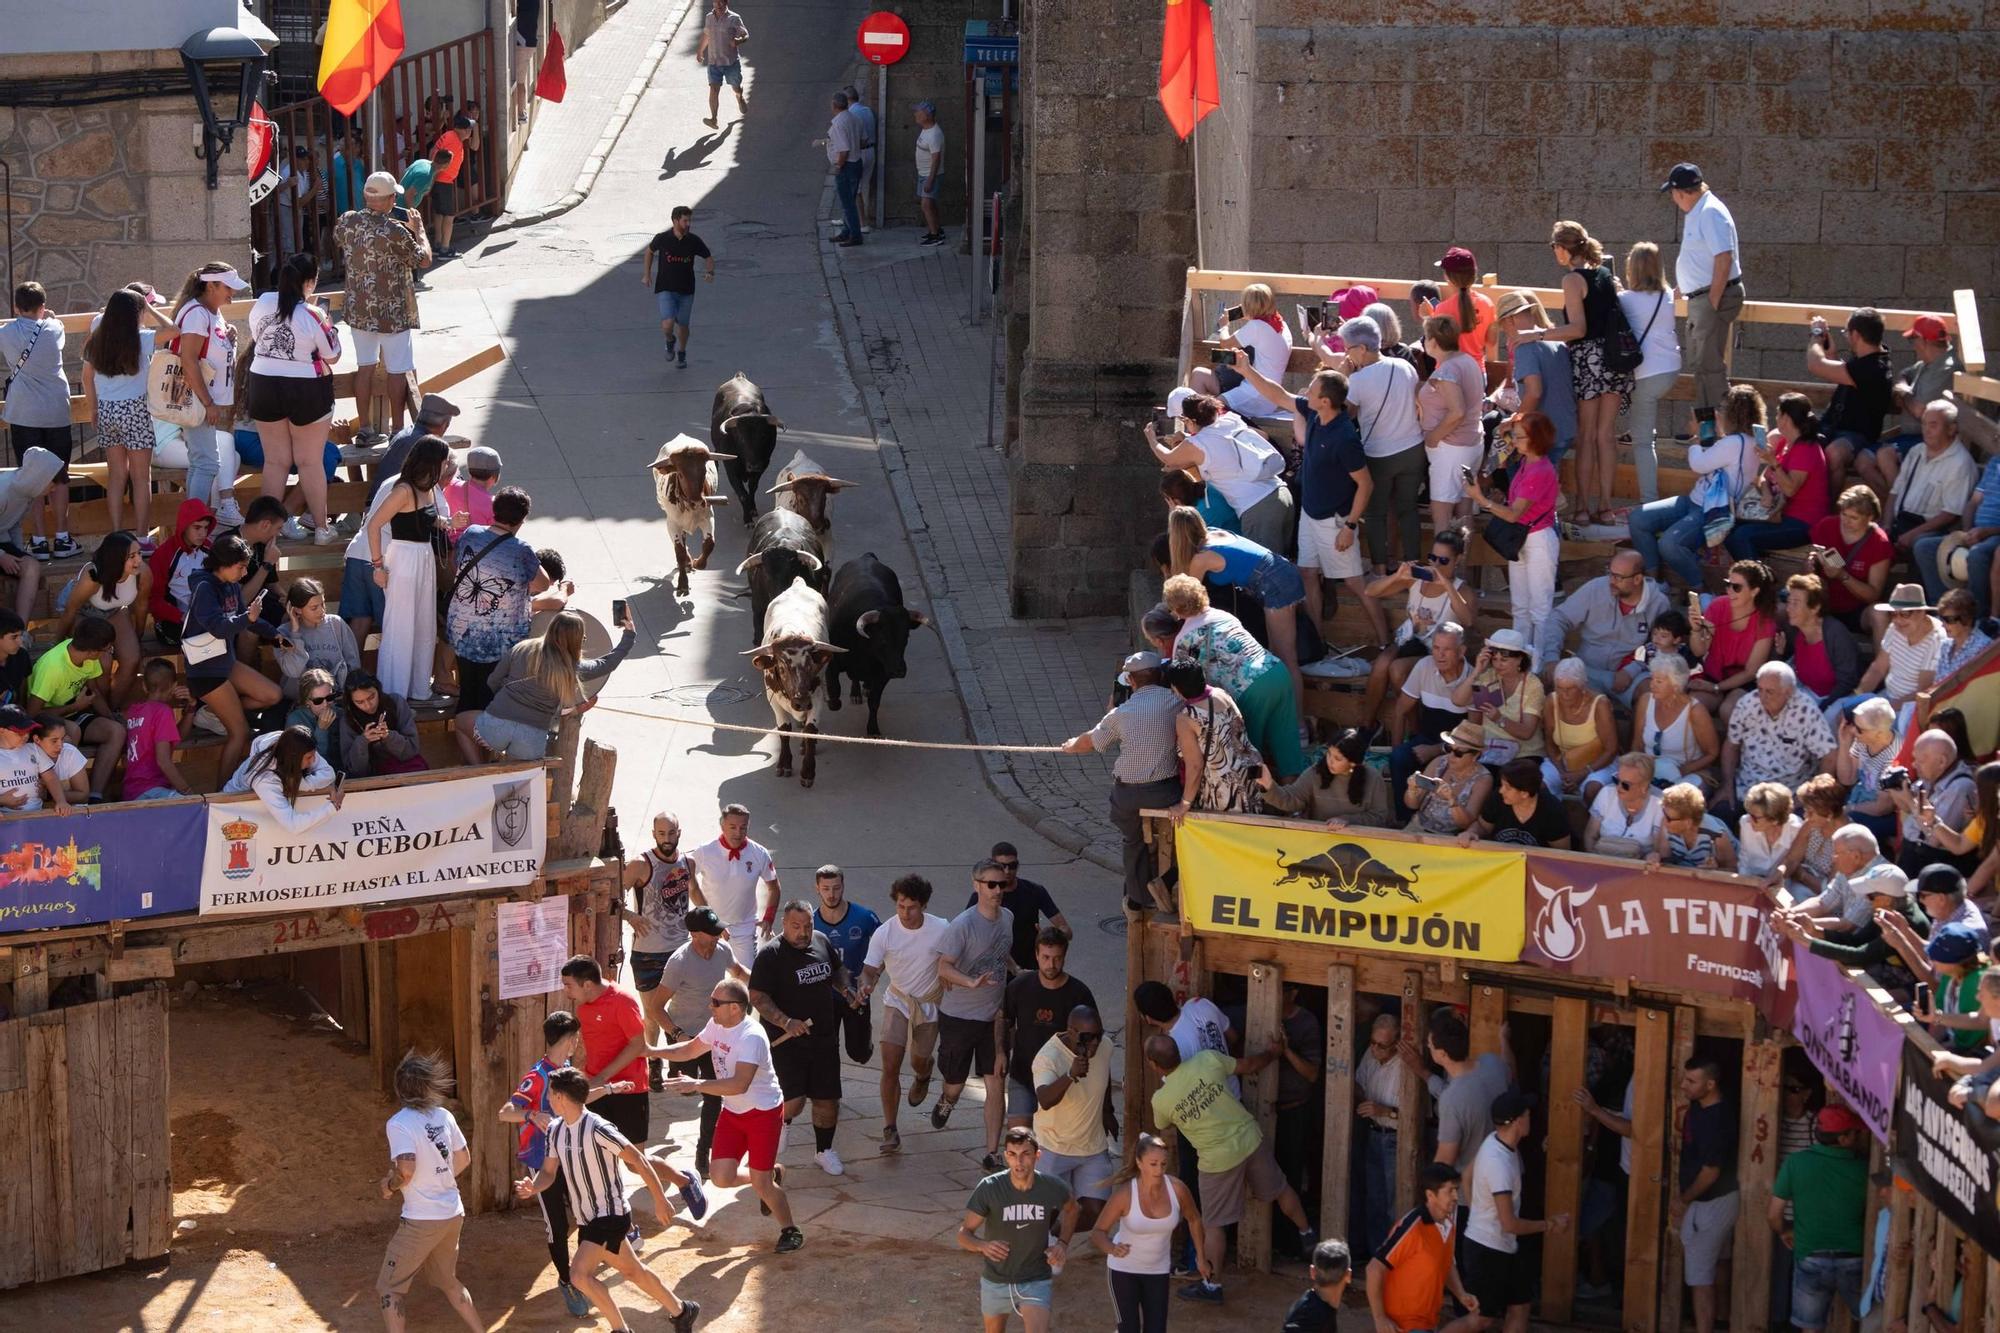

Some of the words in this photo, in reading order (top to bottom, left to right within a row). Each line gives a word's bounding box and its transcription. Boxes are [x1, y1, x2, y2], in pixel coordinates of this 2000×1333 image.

[250, 184, 271, 202] ZA
[267, 841, 349, 866] JUAN
[356, 822, 485, 858] CEBOLLA
[352, 816, 406, 837] PEÑA
[211, 883, 337, 907] FERMOSELLE
[342, 874, 402, 894] HASTA
[407, 870, 430, 885] EL
[434, 858, 537, 882] AMANECER
[274, 917, 321, 944] 21A
[1211, 895, 1260, 928] EL
[1275, 902, 1481, 951] EMPUJÓN
[1598, 899, 1650, 940] LA
[1662, 897, 1789, 992] TENTAÓN
[1687, 953, 1764, 989] Fermosel
[1801, 1023, 1890, 1133] ONTRABANDO
[1002, 1203, 1046, 1222] NIKE
